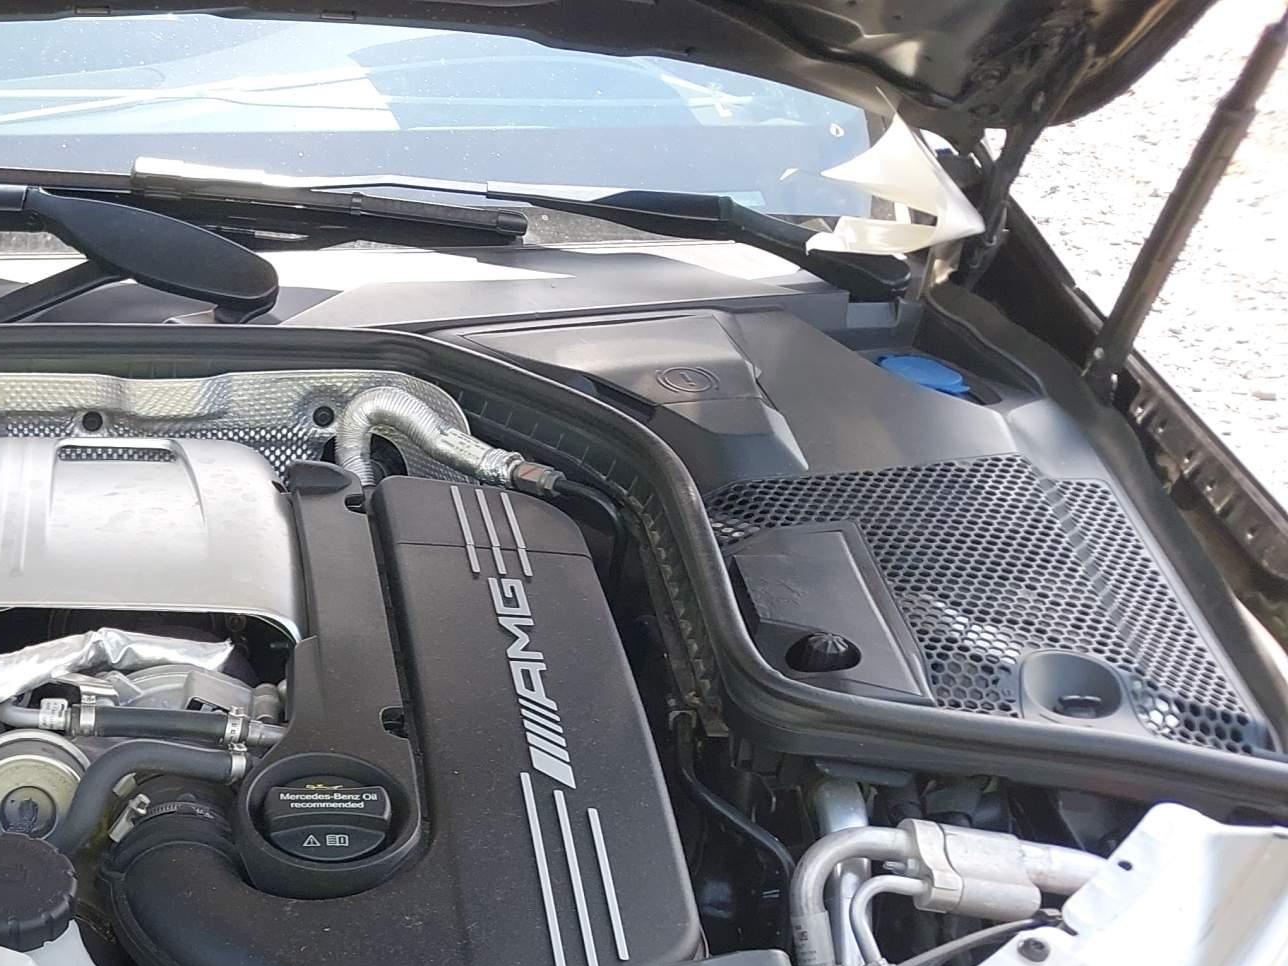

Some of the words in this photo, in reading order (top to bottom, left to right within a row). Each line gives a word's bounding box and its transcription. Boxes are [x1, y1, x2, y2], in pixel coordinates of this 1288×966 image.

[488, 577, 558, 711] AMG
[279, 793, 361, 801] Mercedes-Benz
[290, 801, 364, 809] recommended
